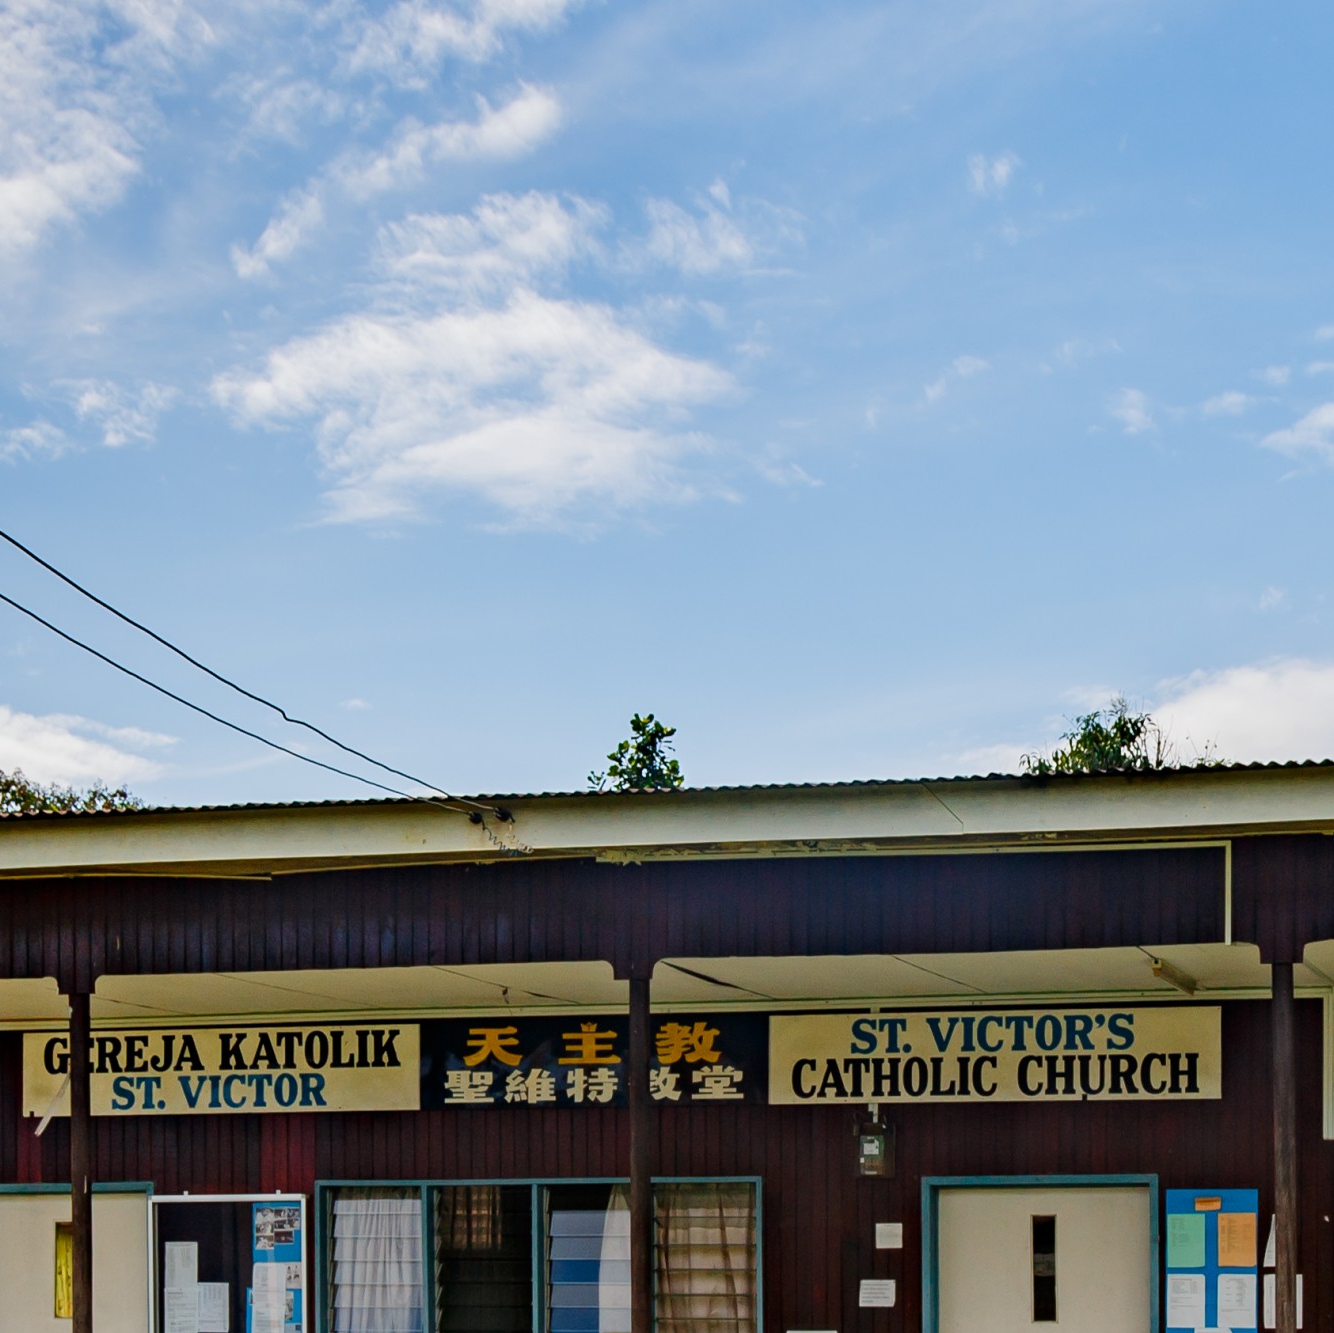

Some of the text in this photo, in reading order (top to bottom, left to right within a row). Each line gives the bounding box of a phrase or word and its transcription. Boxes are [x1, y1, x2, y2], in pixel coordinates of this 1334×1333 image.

[43, 1029, 402, 1075] GREJA KATOLIK
[462, 1021, 723, 1067] 天主教
[850, 1012, 1135, 1055] ST. VICTOR'S
[111, 1072, 328, 1111] ST. VICTOR
[791, 1052, 1200, 1099] CATHOLIC CHURCH
